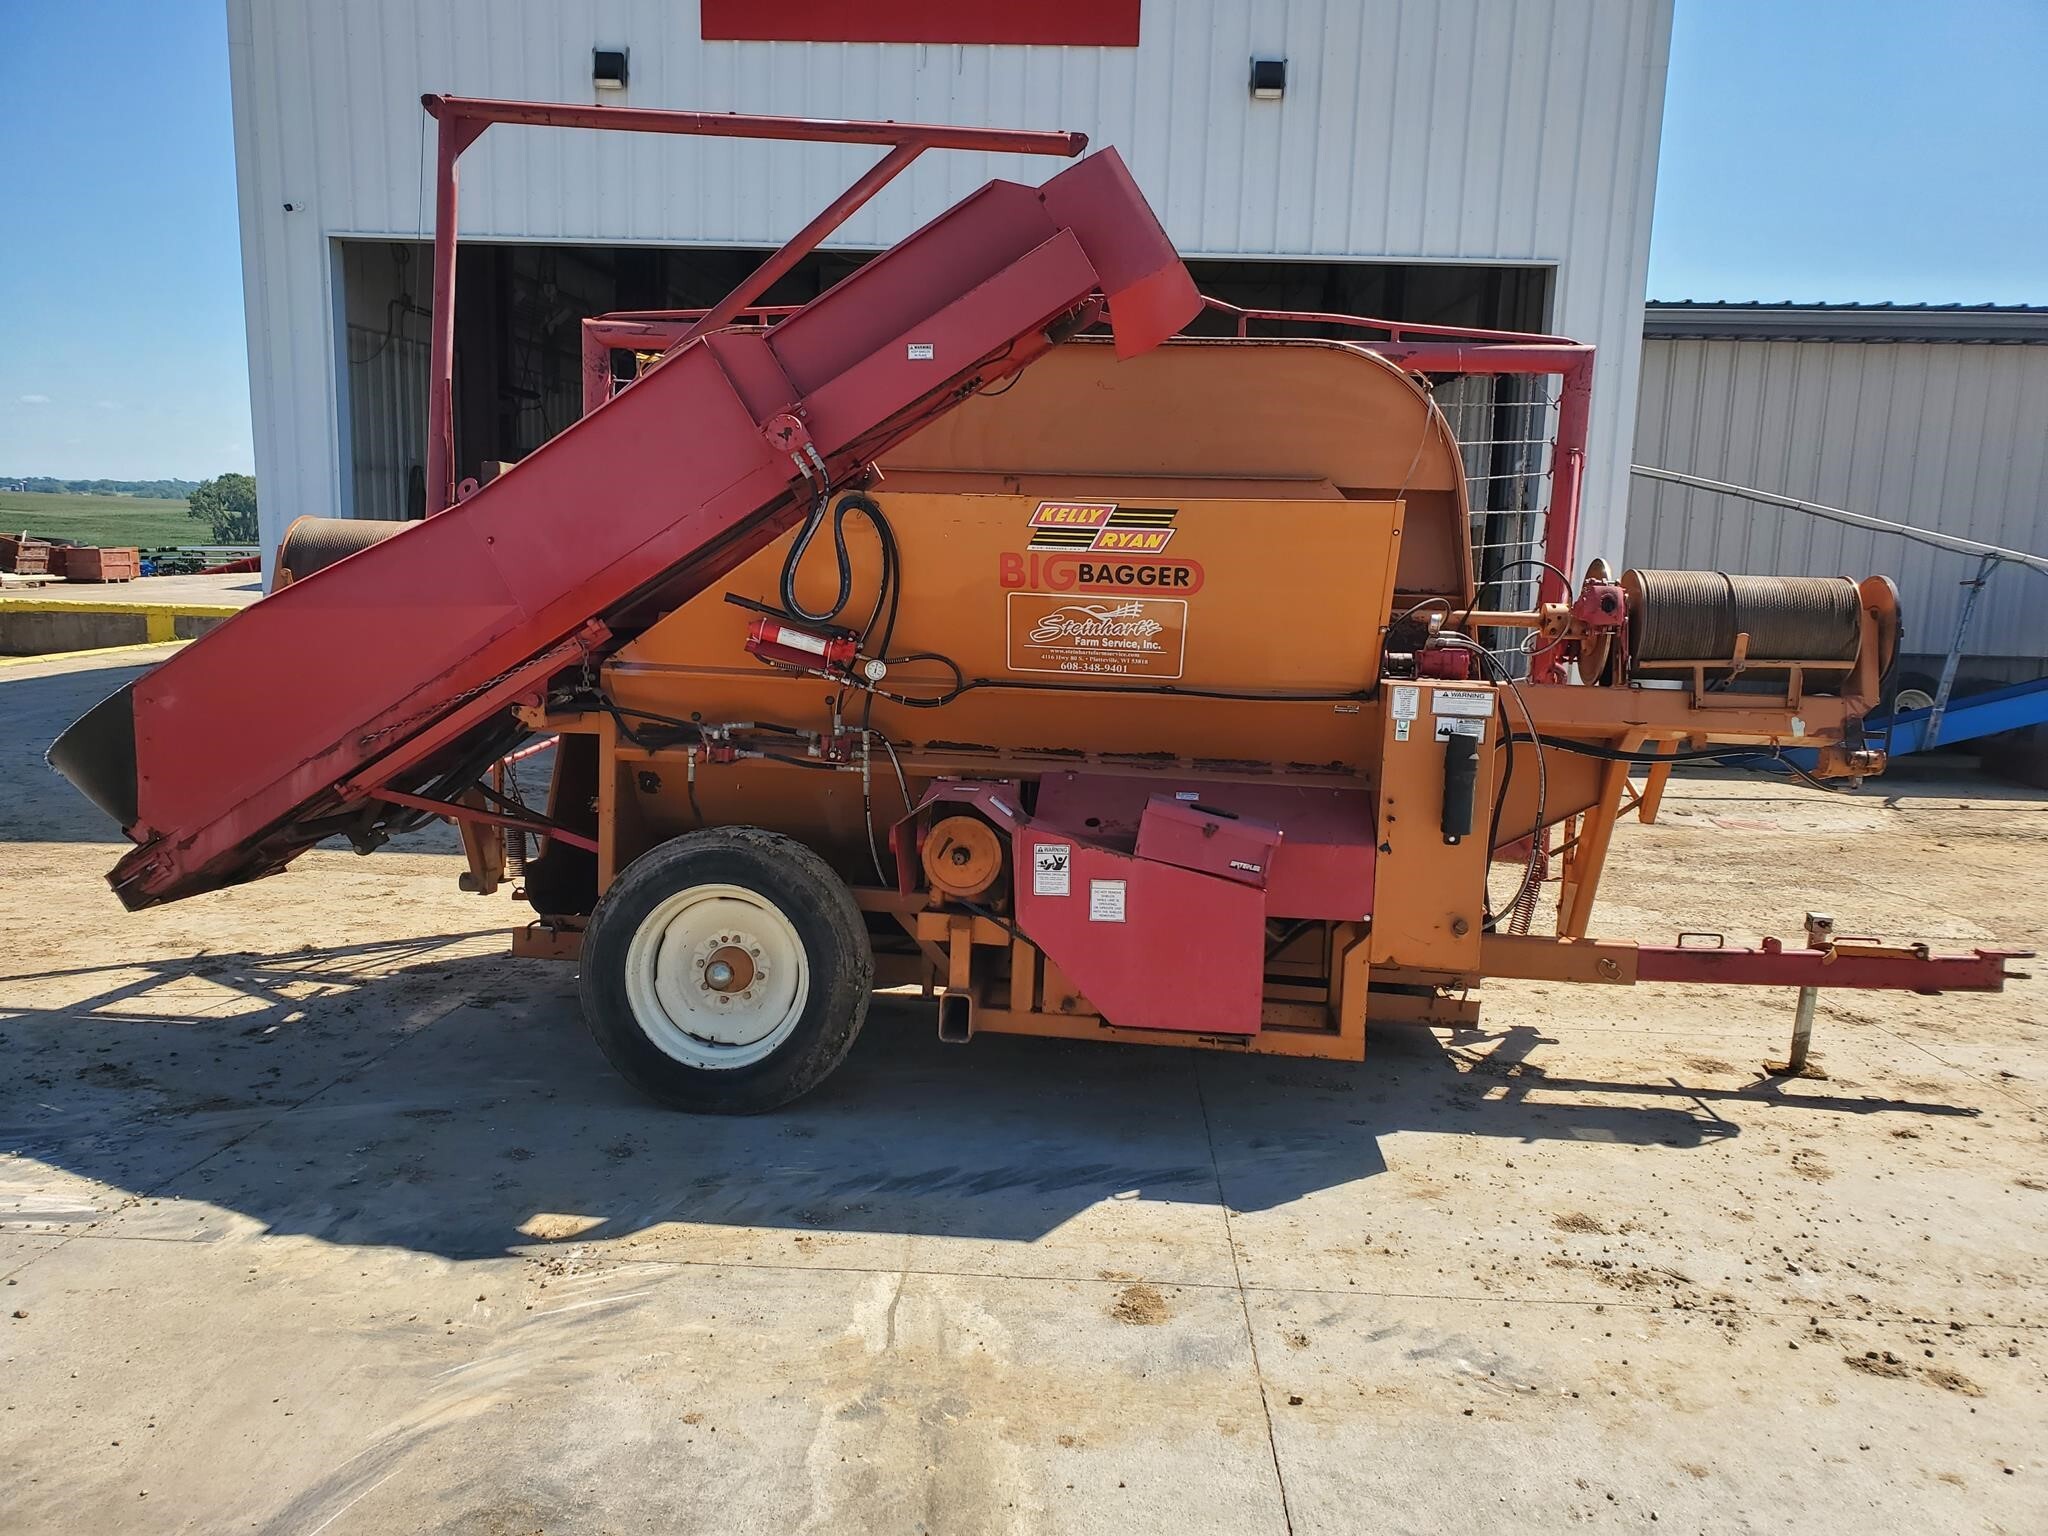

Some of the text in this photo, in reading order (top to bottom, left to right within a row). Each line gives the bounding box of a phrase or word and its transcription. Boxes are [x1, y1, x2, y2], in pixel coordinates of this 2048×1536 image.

[1038, 506, 1106, 524] KELLY
[1098, 532, 1165, 549] RYAN
[999, 551, 1190, 591] BIG BAGGER
[1029, 613, 1163, 643] Steinhart's
[1074, 636, 1162, 650] Farm Service, Inc.
[1060, 662, 1128, 673] 608-348-9401
[1450, 691, 1485, 699] WARNING
